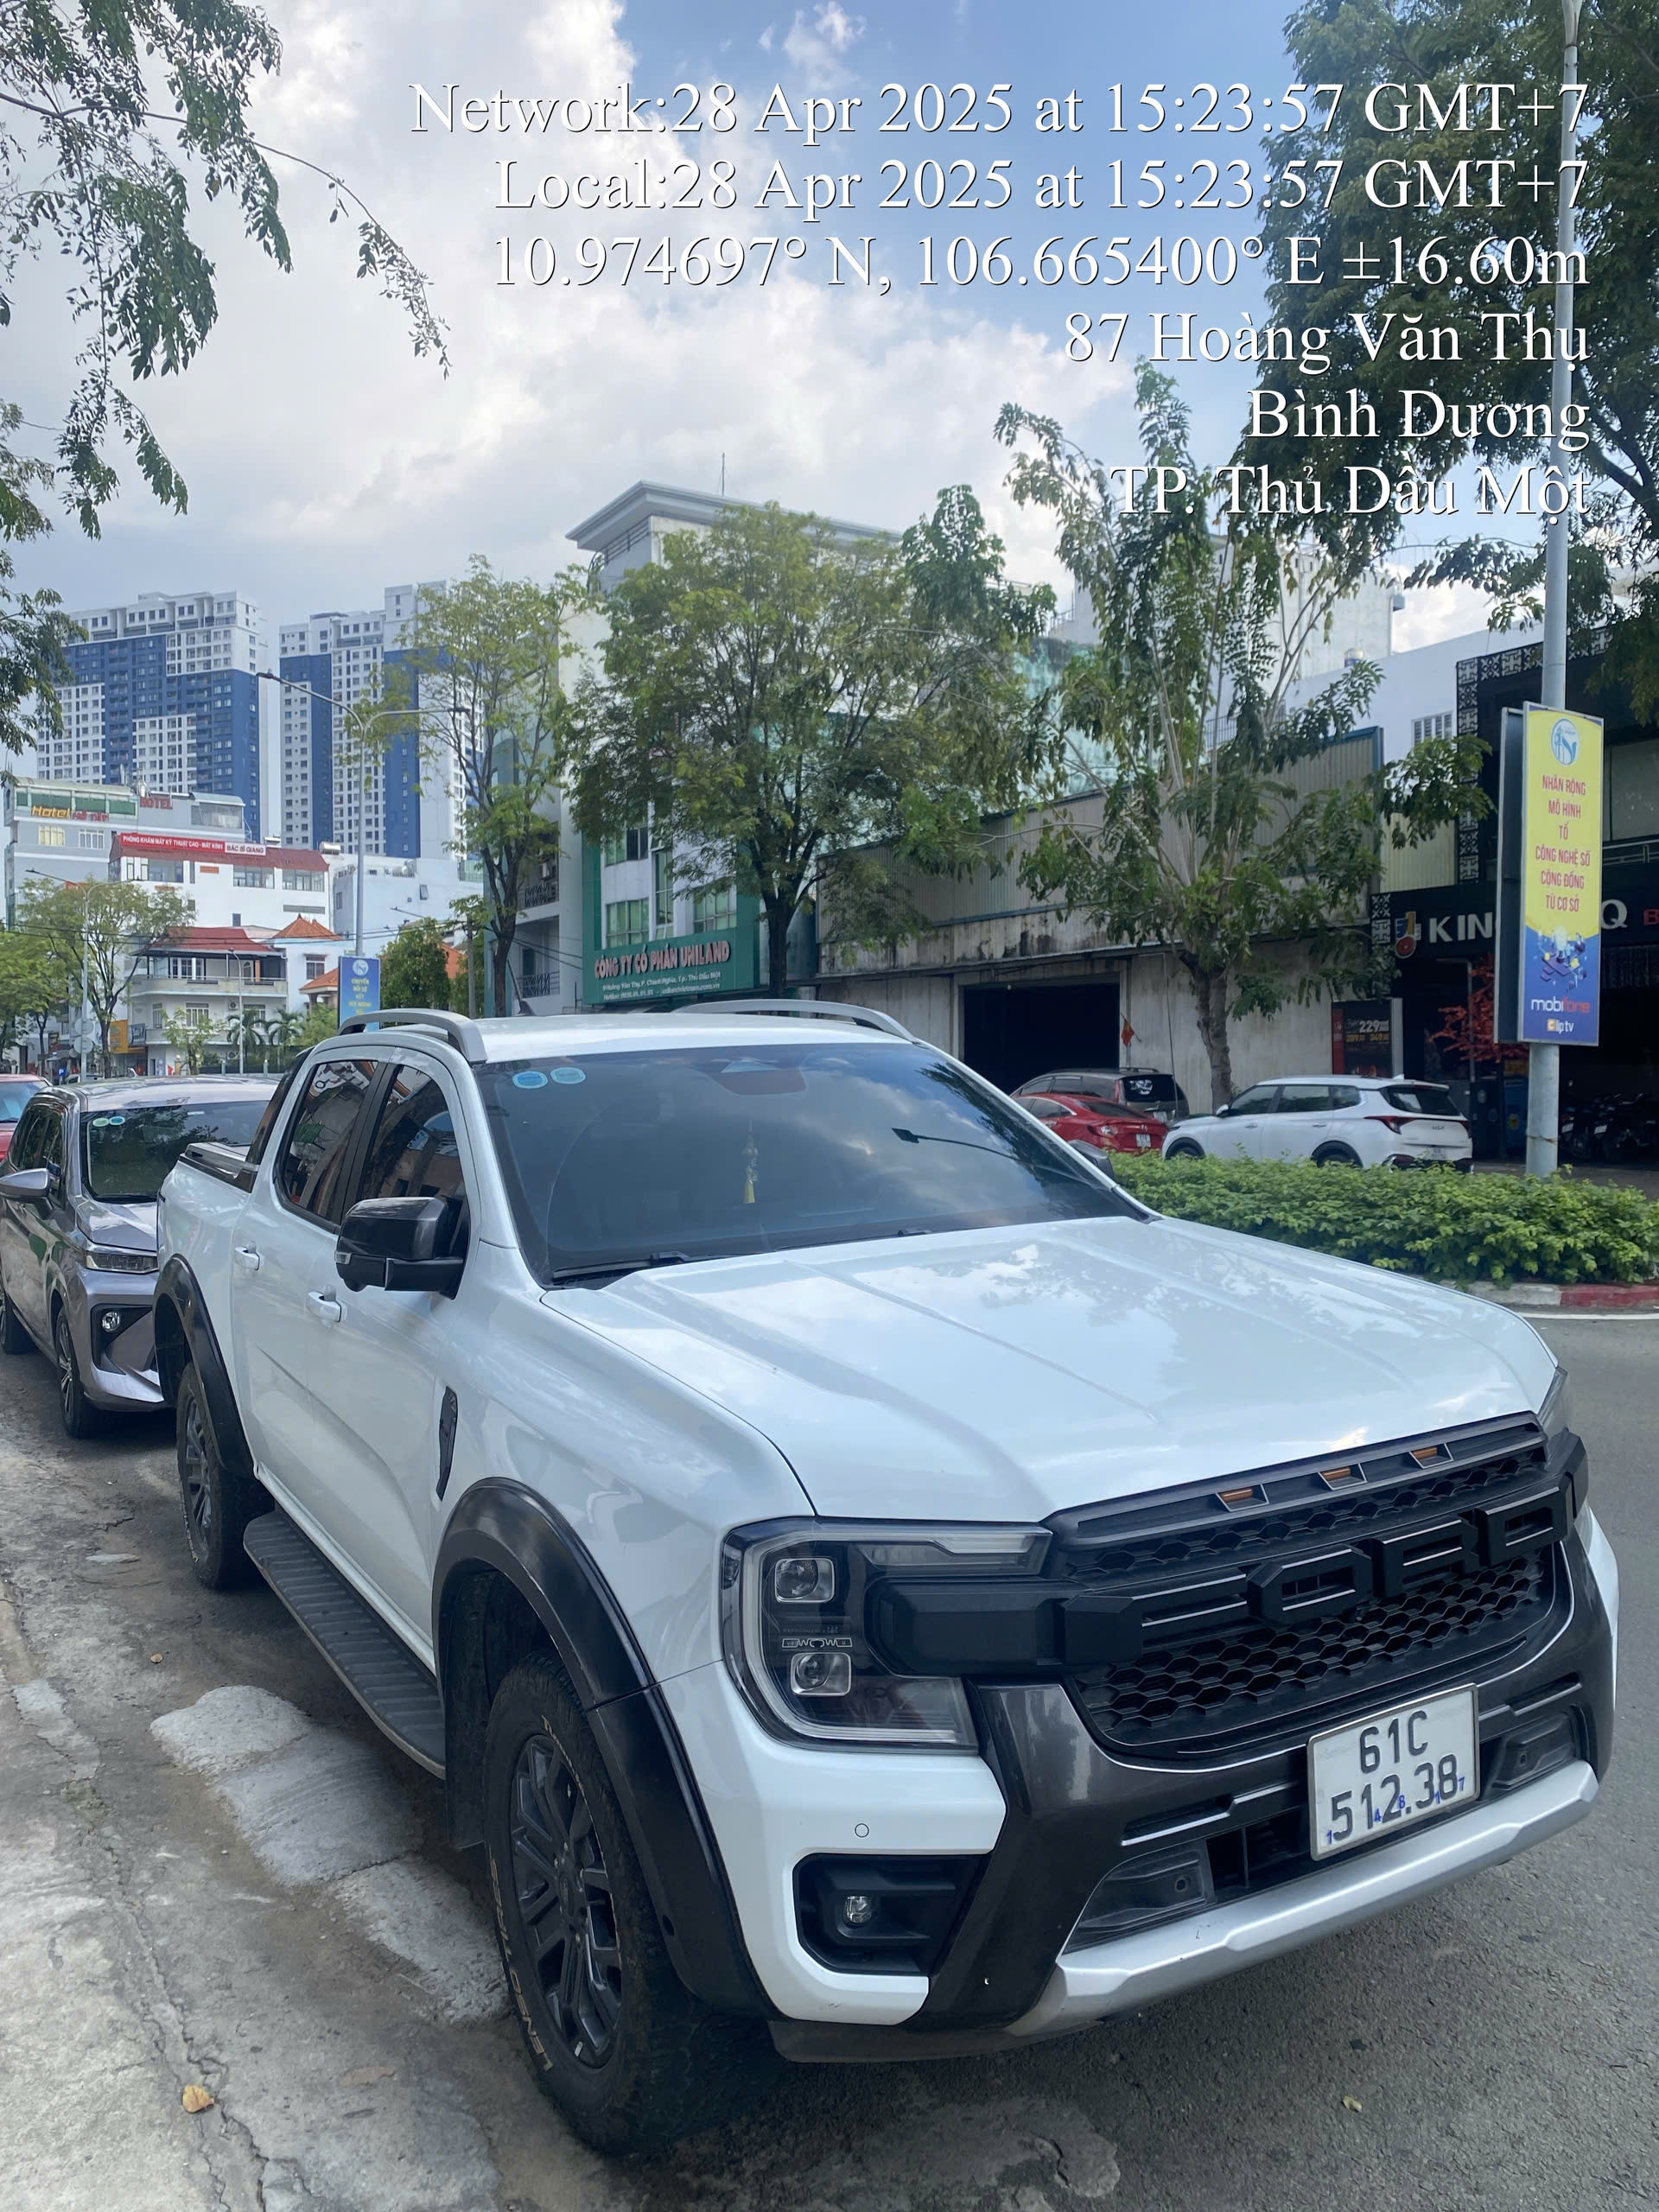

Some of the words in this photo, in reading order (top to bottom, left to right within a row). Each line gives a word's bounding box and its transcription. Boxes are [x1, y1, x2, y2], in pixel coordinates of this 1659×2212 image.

[1566, 778, 1586, 797] RỘNG
[32, 805, 71, 819] Hotel
[1548, 798, 1560, 815] MÔ
[1563, 802, 1581, 819] HÌNH
[1535, 843, 1555, 861] CÔNG
[1558, 849, 1578, 868] NGHỆ
[1580, 849, 1591, 868] SỐ
[1557, 897, 1567, 912] CƠ
[1429, 912, 1497, 944] KIN
[1600, 899, 1629, 931] Q
[594, 954, 620, 980] CÔNG
[620, 955, 633, 976] TY
[635, 944, 648, 974] CỔ
[681, 940, 732, 969] UNILAND
[1531, 995, 1592, 1016] mobifone
[1359, 1710, 1428, 1774] 61C
[1332, 1753, 1459, 1841] 512.38
